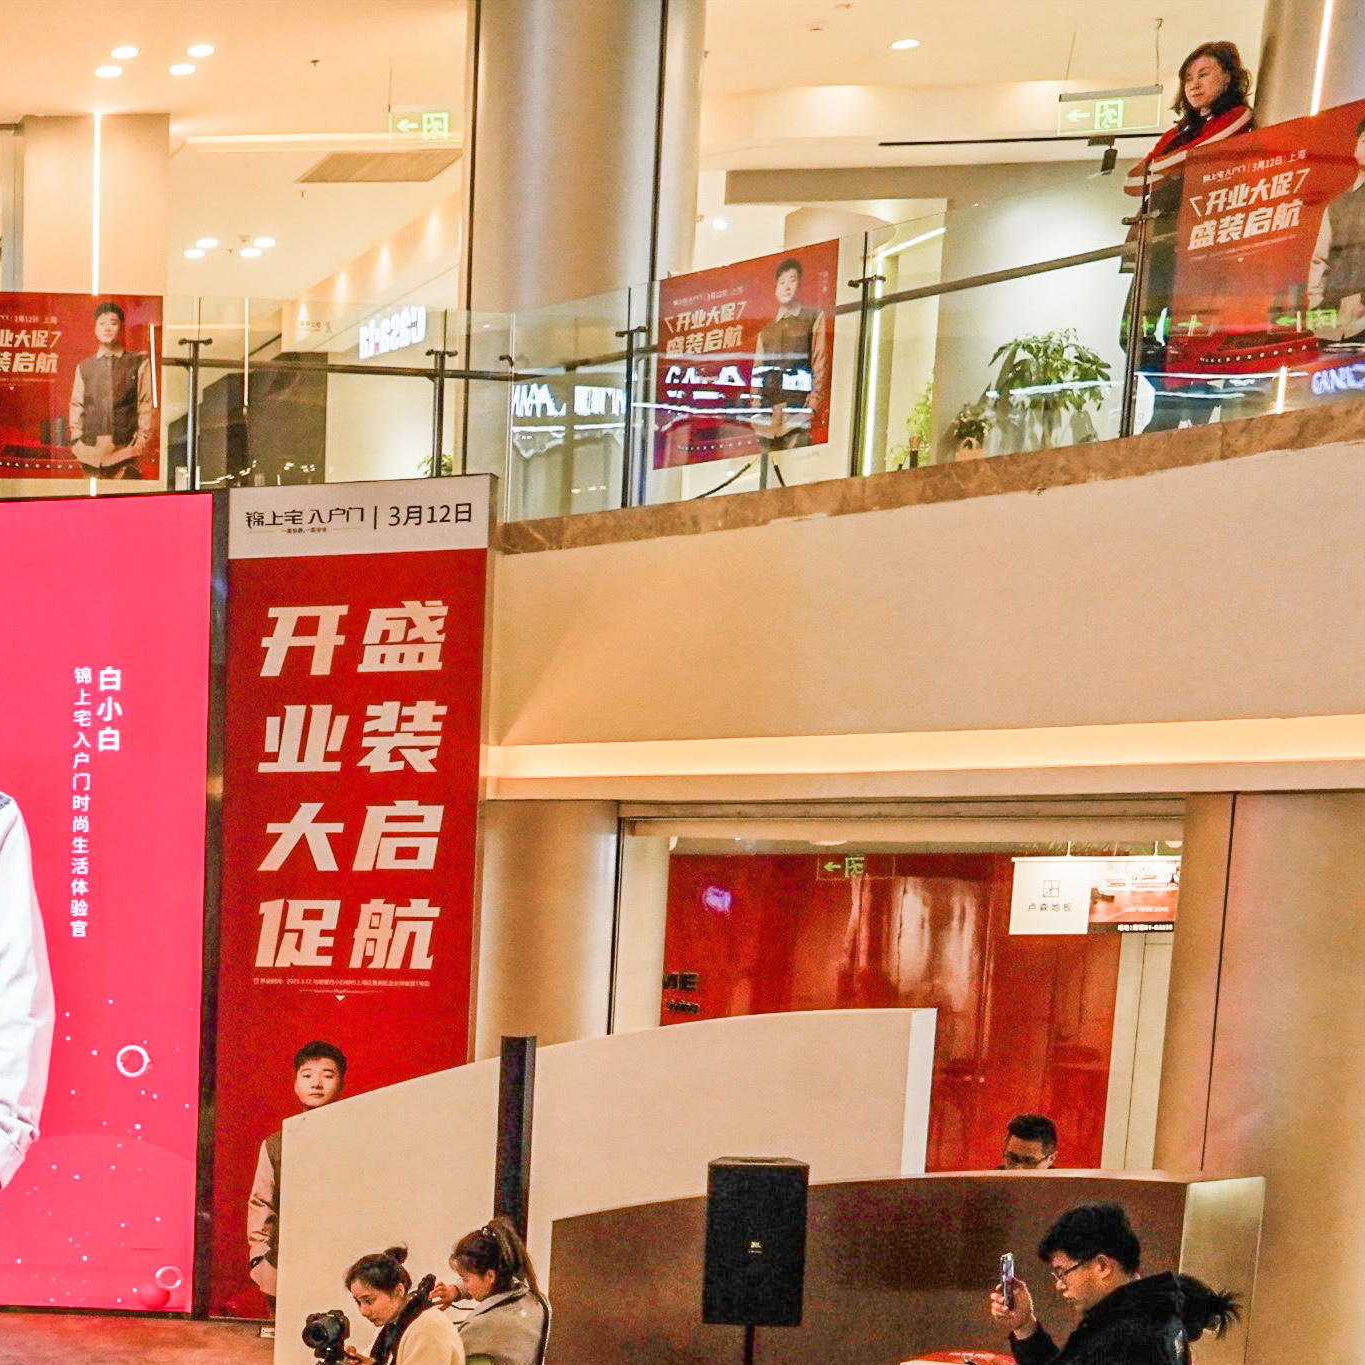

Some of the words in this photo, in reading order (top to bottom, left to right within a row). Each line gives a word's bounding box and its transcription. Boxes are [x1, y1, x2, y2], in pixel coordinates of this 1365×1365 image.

[1187, 199, 1303, 250] 盛装启航
[1205, 171, 1293, 216] 开业大促
[676, 301, 736, 333] 开业大促
[388, 503, 472, 527] 3月12日
[97, 666, 123, 752] 白小白
[70, 667, 92, 938] 锦上宅入户门时尚生活体验官
[255, 604, 349, 968] 开业大促
[349, 601, 448, 969] 盛装启航
